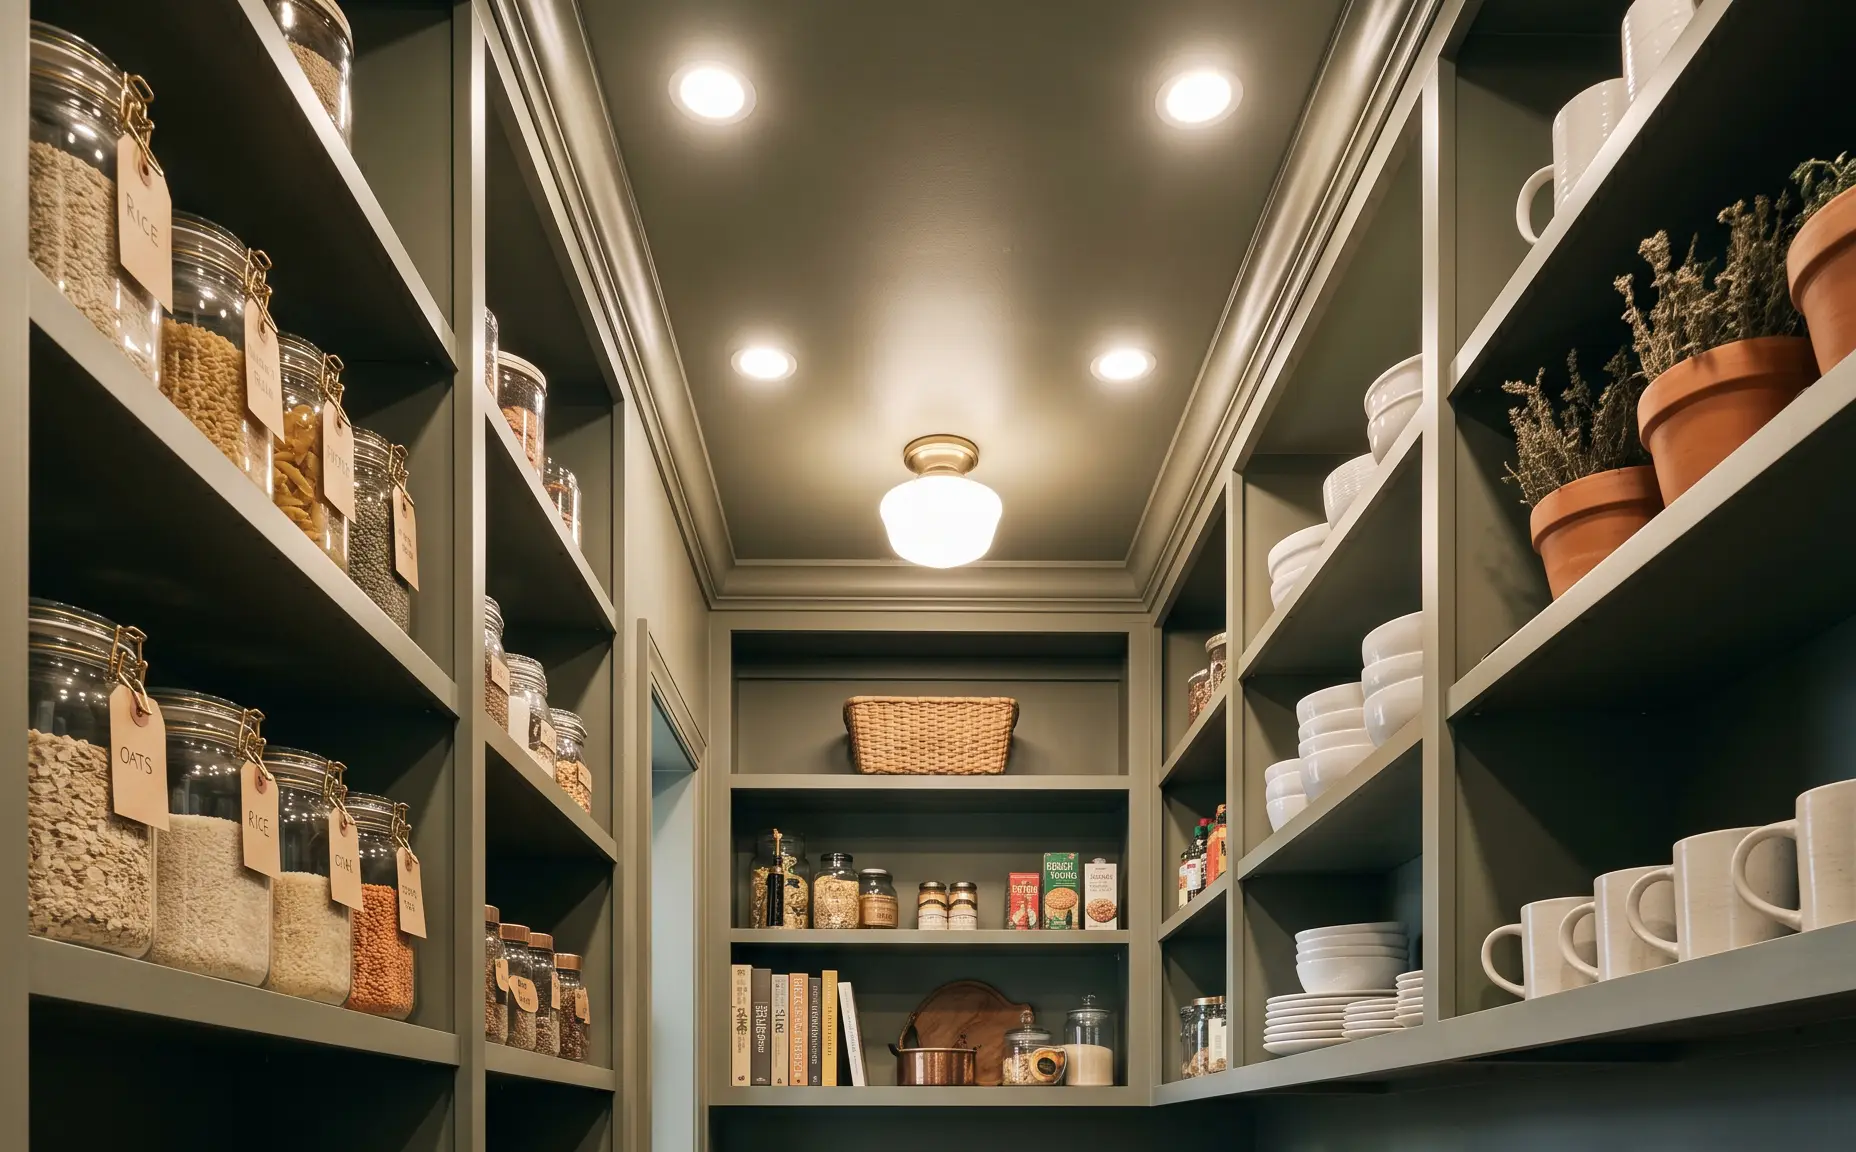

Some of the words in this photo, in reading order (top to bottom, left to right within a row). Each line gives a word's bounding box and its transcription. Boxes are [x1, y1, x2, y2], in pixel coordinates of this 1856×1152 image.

[126, 192, 159, 247] RICE
[120, 746, 153, 775] OATS
[248, 810, 270, 838] RICE
